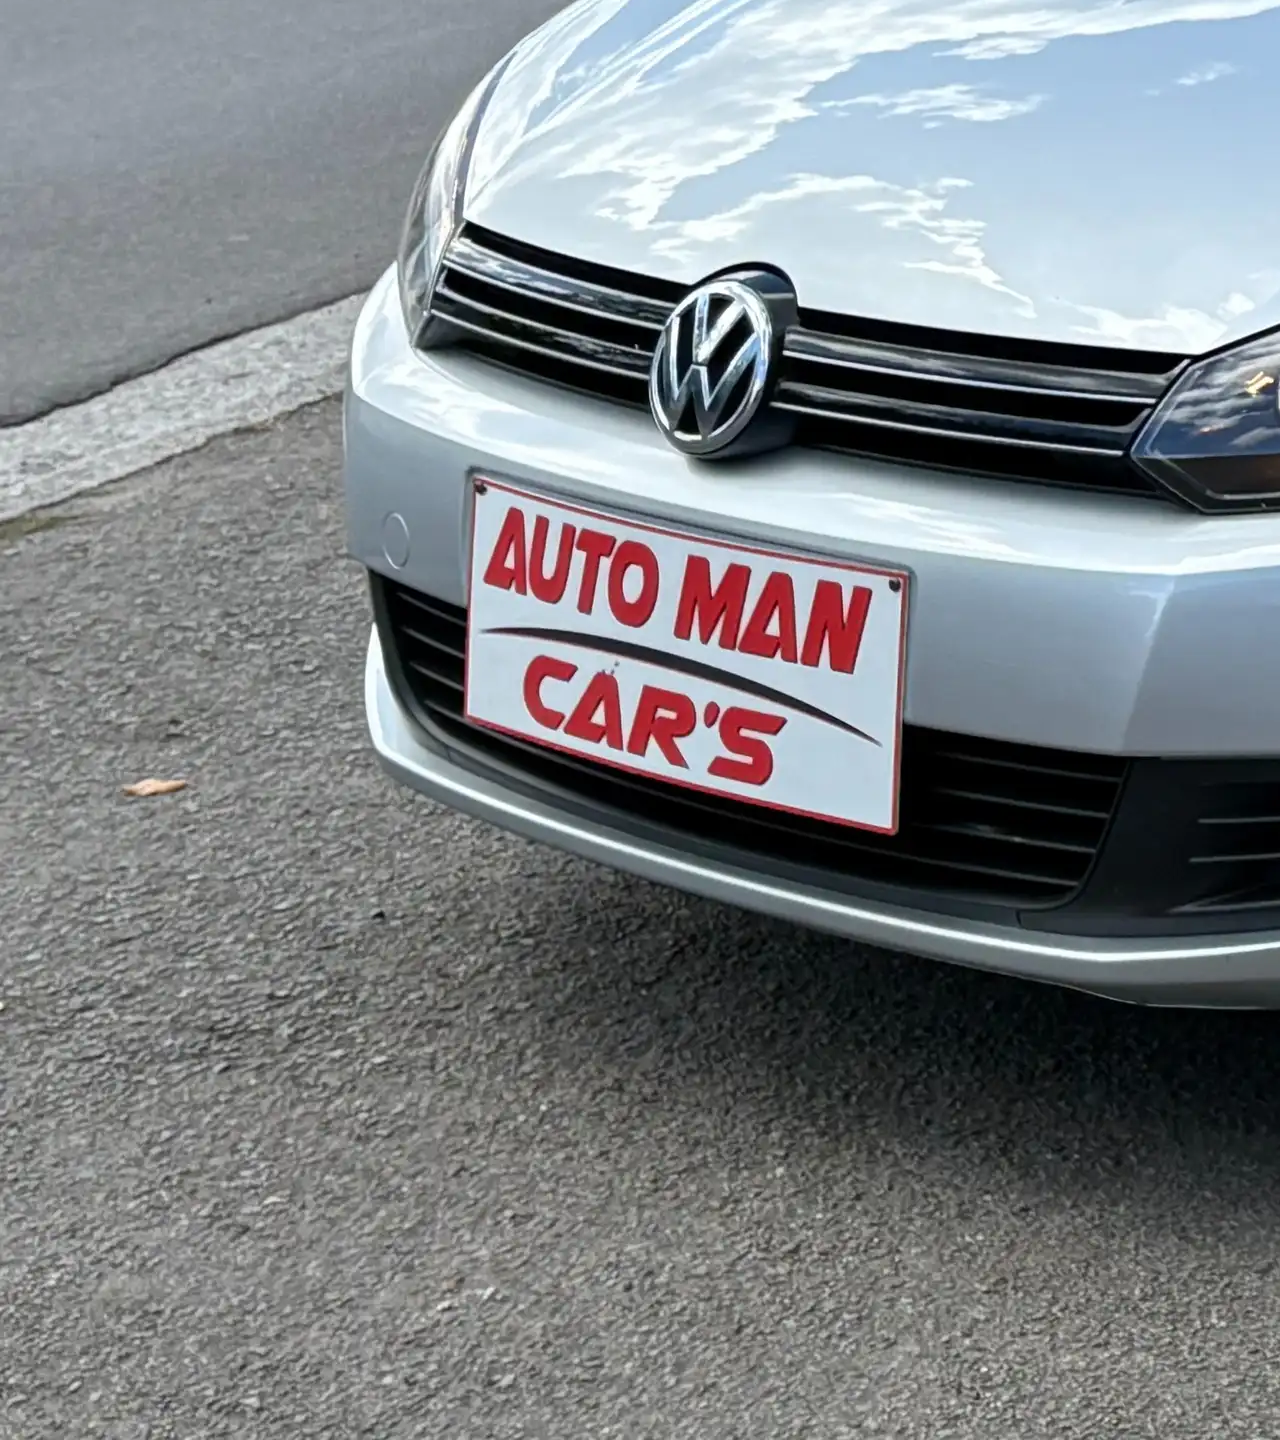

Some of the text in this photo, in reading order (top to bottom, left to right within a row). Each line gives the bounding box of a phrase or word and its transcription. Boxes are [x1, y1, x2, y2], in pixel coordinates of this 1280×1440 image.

[483, 506, 873, 675] AUTO MAN
[522, 654, 788, 787] CAR'S
